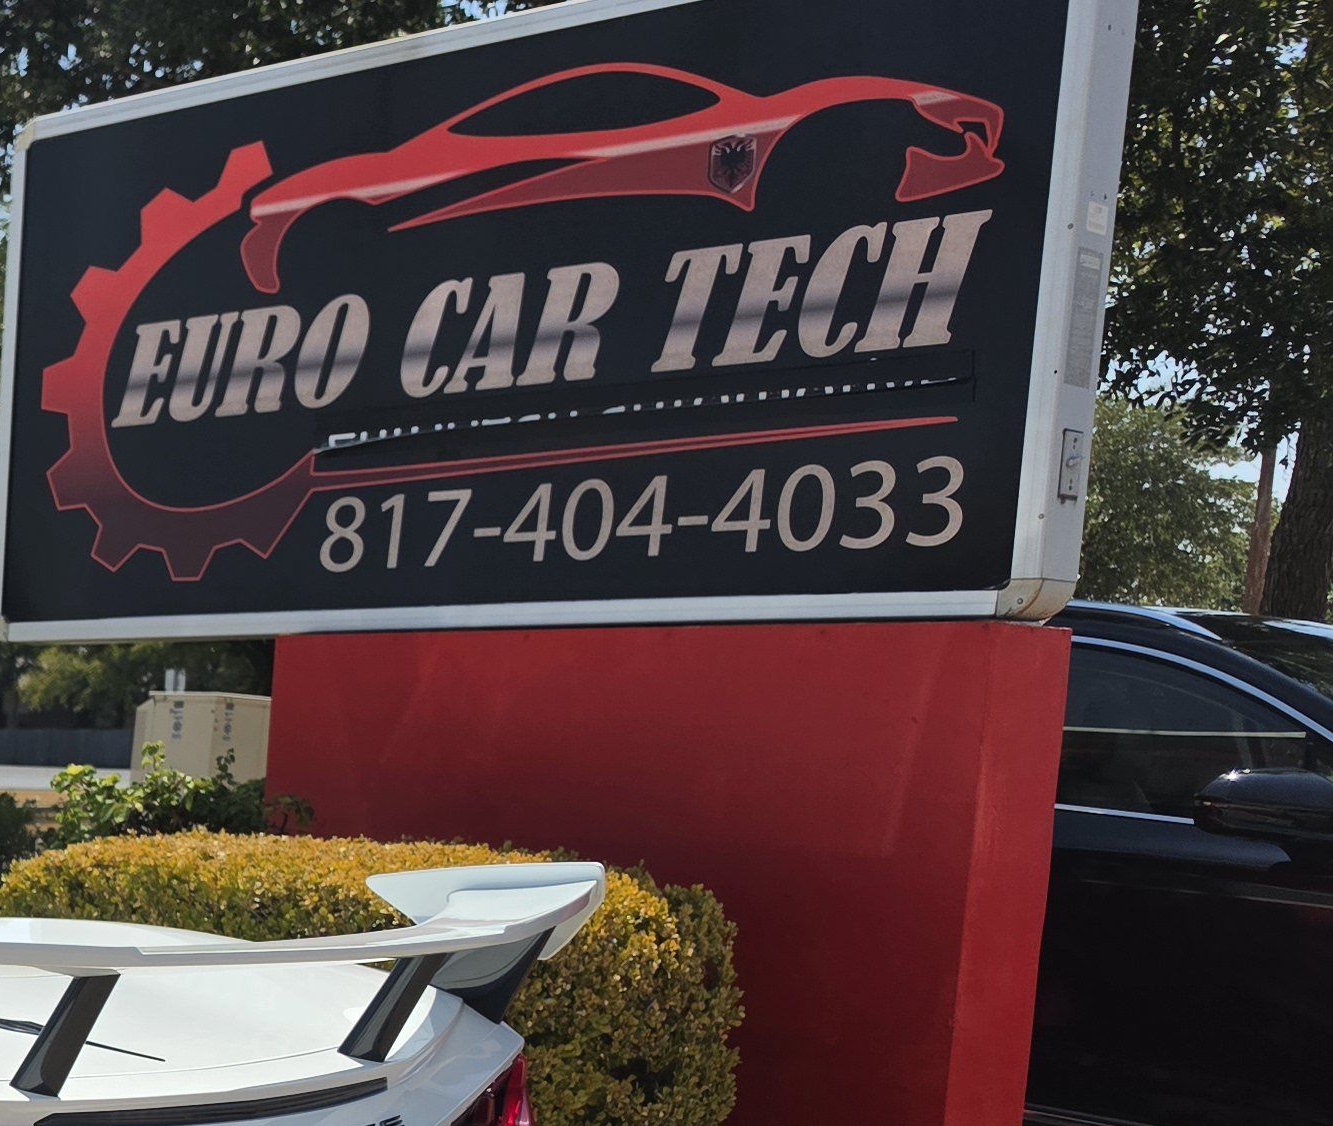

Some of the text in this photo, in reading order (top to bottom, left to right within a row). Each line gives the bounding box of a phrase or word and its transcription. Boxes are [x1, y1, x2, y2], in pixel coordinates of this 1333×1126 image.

[111, 293, 371, 428] EURO
[400, 261, 620, 398] CAR
[650, 208, 993, 373] TECH
[318, 455, 965, 573] 817-404-4033
